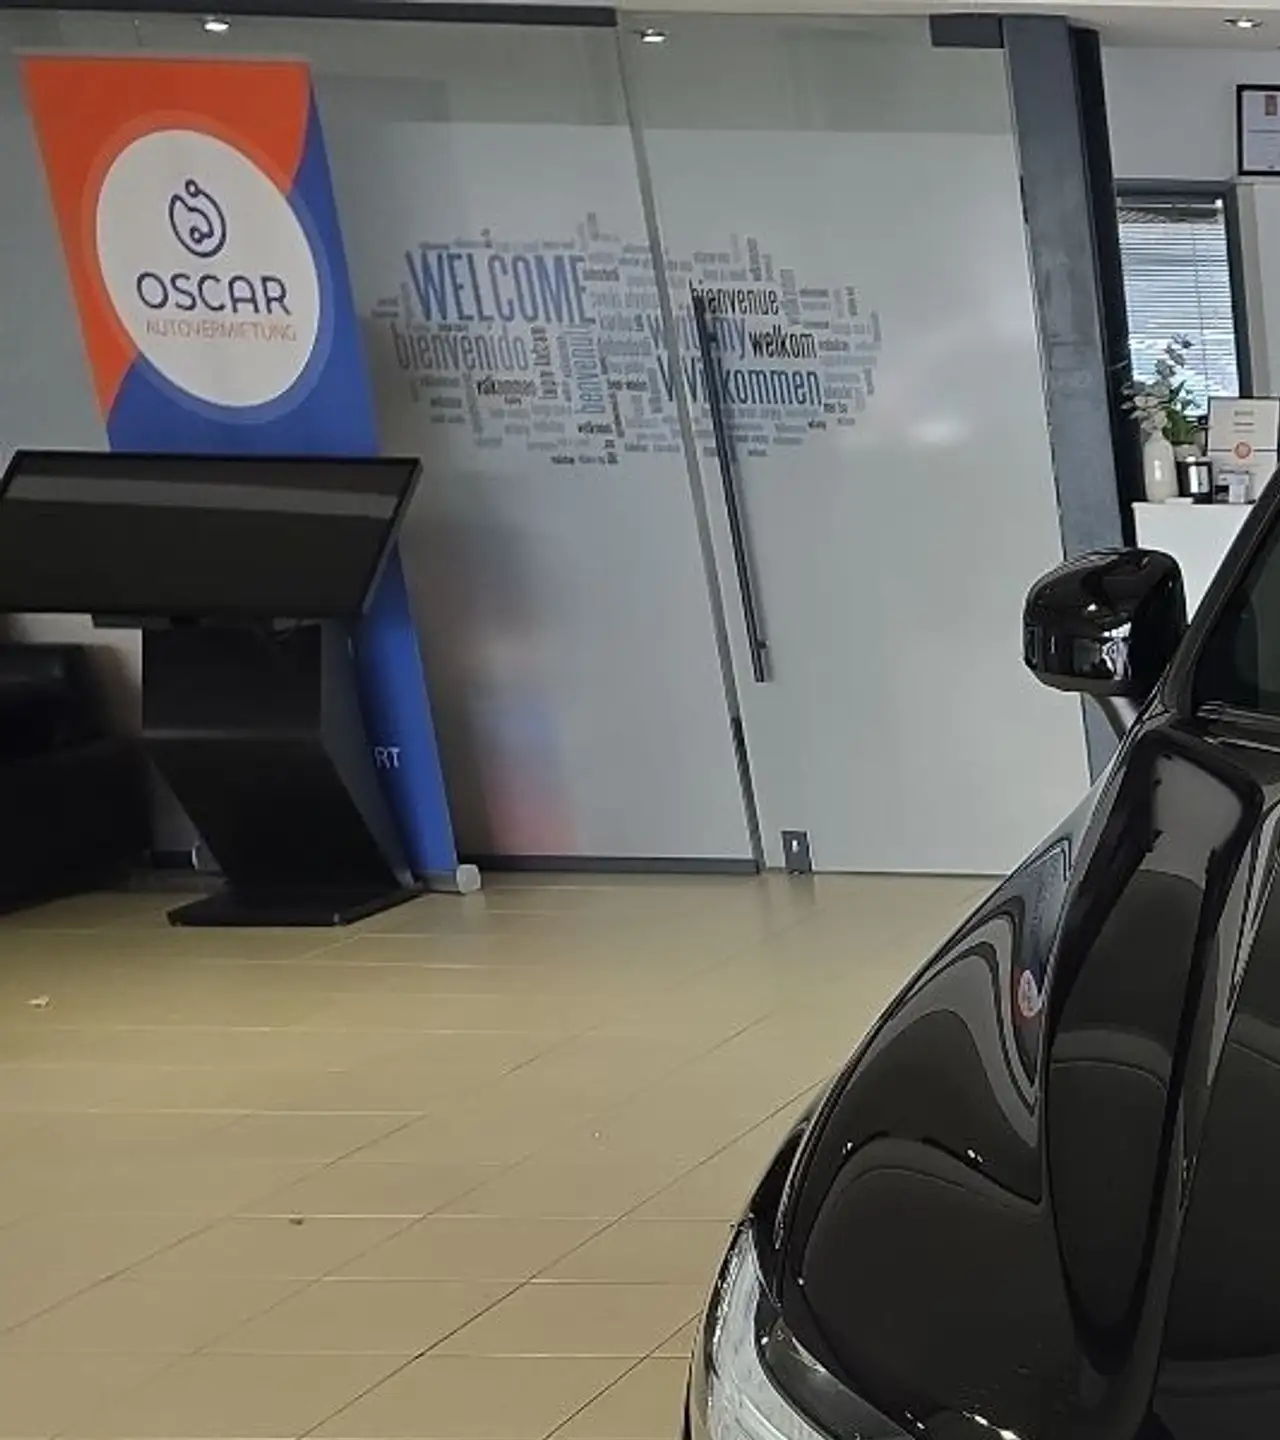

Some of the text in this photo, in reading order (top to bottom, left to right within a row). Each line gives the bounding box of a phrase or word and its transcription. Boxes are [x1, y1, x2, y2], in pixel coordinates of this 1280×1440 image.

[136, 272, 292, 315] OSCAR
[405, 249, 597, 325] WELCOME
[390, 321, 529, 371] bienvenido
[749, 324, 819, 359] welkom
